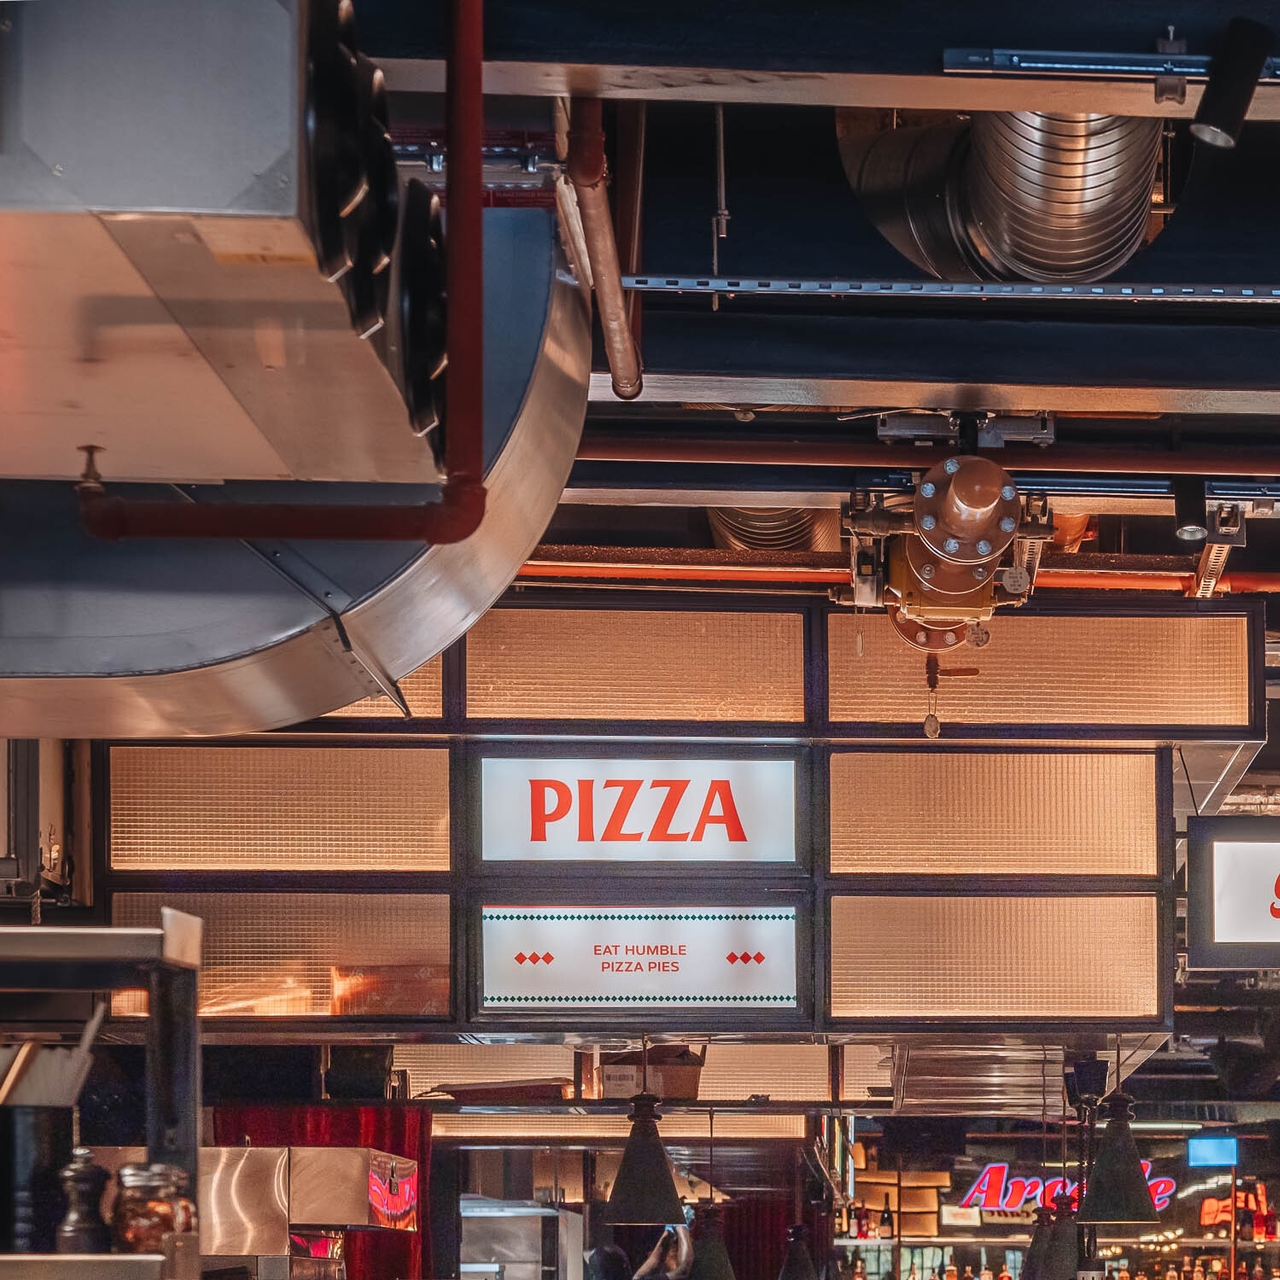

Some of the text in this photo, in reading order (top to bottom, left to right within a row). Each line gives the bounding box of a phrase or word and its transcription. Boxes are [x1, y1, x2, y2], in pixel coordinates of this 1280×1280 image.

[528, 779, 748, 842] PIZZA
[593, 944, 687, 956] EAT HUMBLE
[601, 961, 680, 972] PIZZA PIES
